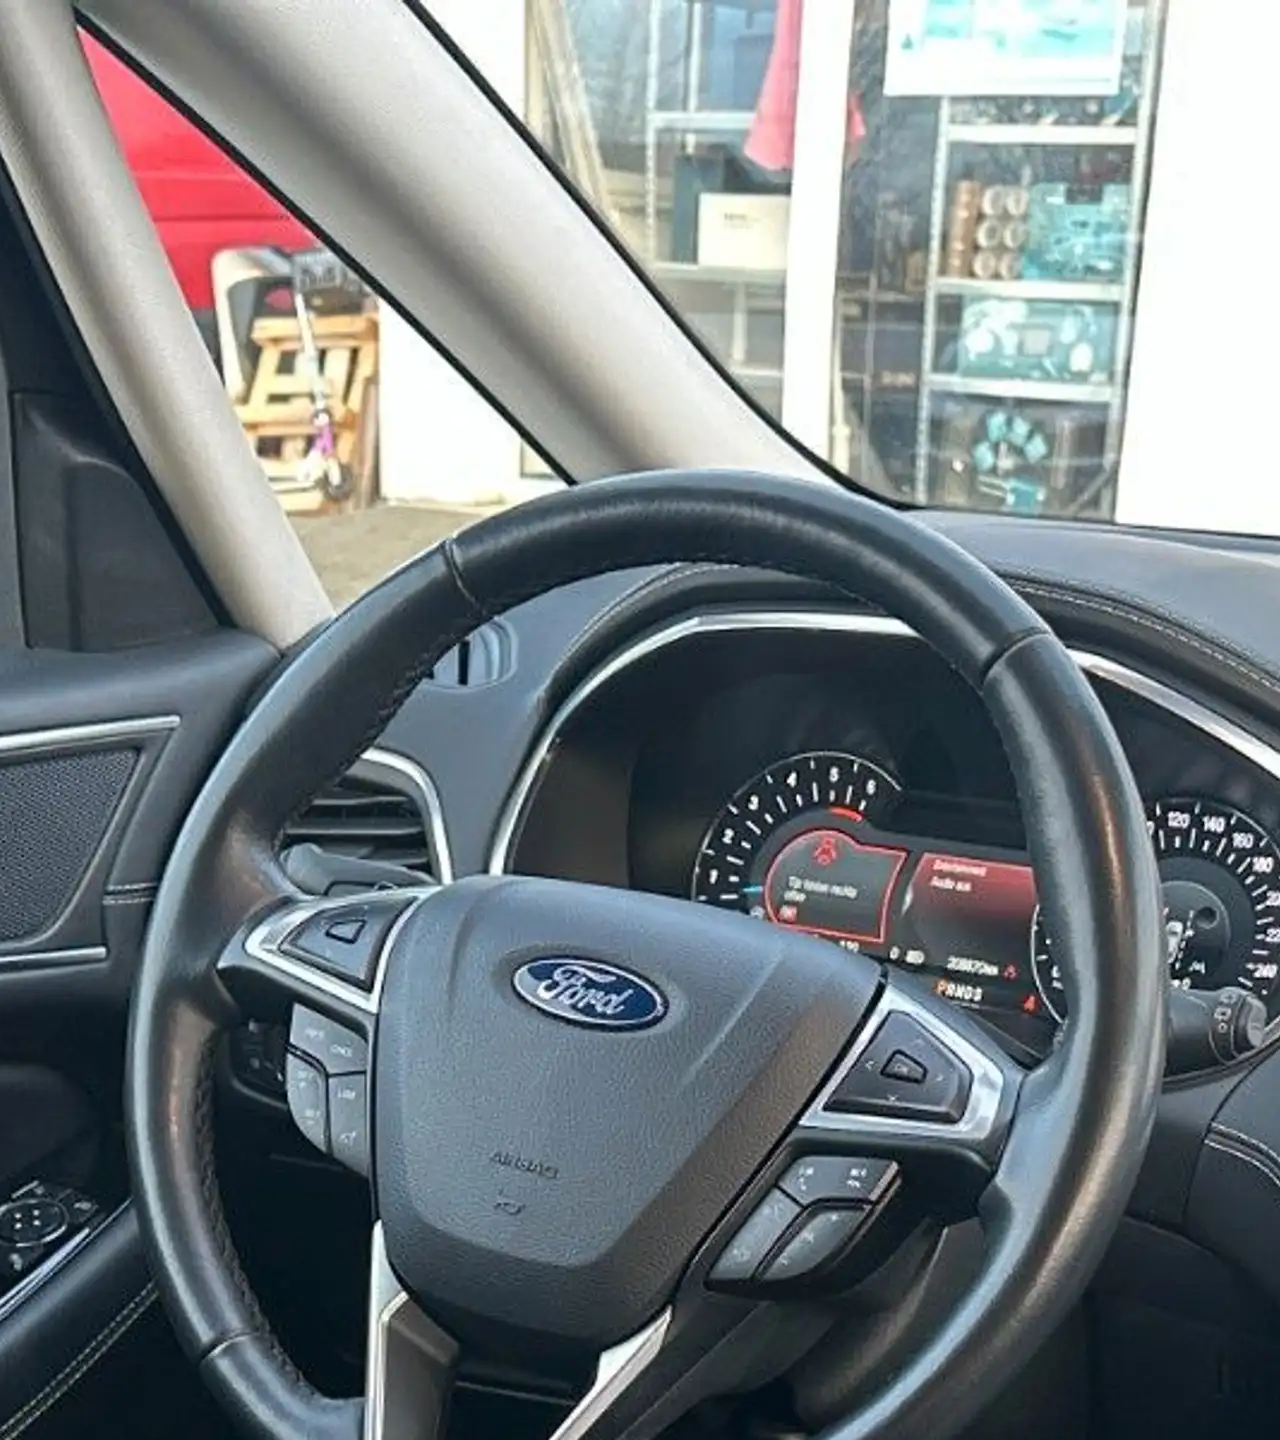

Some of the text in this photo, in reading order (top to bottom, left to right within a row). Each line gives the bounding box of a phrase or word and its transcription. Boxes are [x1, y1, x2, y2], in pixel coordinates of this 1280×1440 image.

[1166, 811, 1191, 828] 120
[1202, 815, 1226, 833] 140
[1230, 831, 1255, 849] 160
[1252, 855, 1274, 875] 180
[1253, 963, 1278, 980] 240
[536, 964, 627, 1014] Ford
